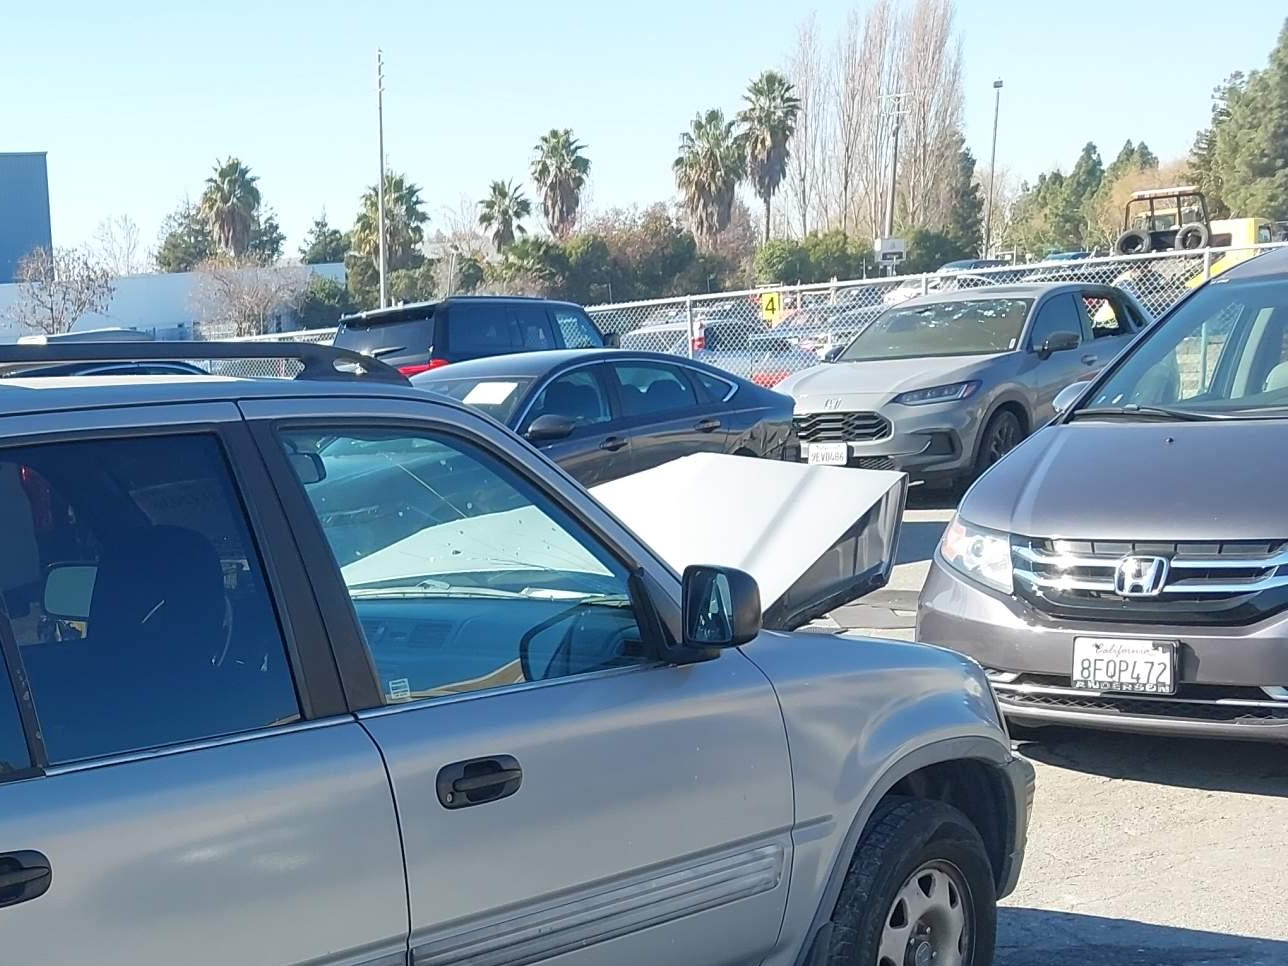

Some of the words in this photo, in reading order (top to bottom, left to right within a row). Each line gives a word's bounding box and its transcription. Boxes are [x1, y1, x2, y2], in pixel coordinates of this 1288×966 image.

[765, 296, 776, 314] 4
[1080, 658, 1167, 684] 8FQP472
[1075, 680, 1170, 693] ANDERSON
